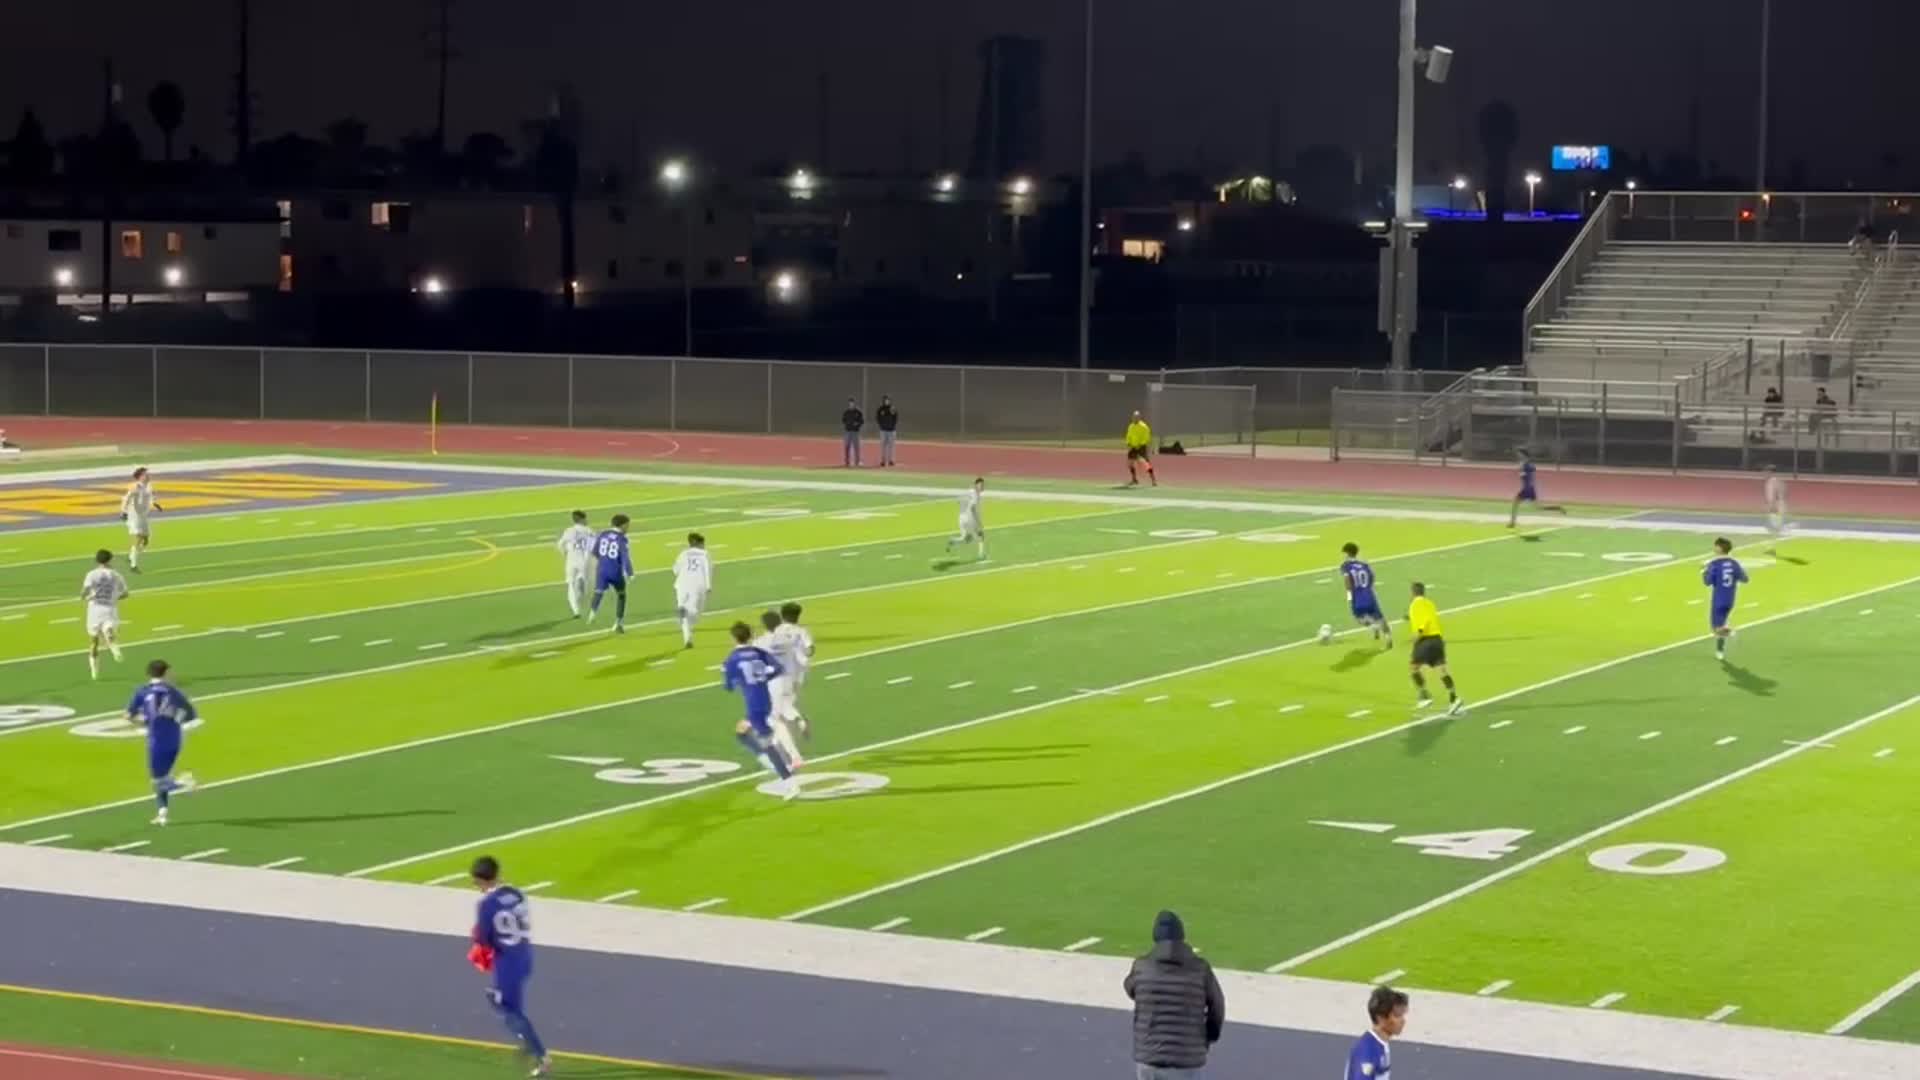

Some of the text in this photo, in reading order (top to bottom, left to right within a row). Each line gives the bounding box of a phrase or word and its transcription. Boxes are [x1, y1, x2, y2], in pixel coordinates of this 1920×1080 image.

[598, 538, 620, 559] 88
[1350, 568, 1369, 588] 10
[1722, 568, 1733, 588] 5
